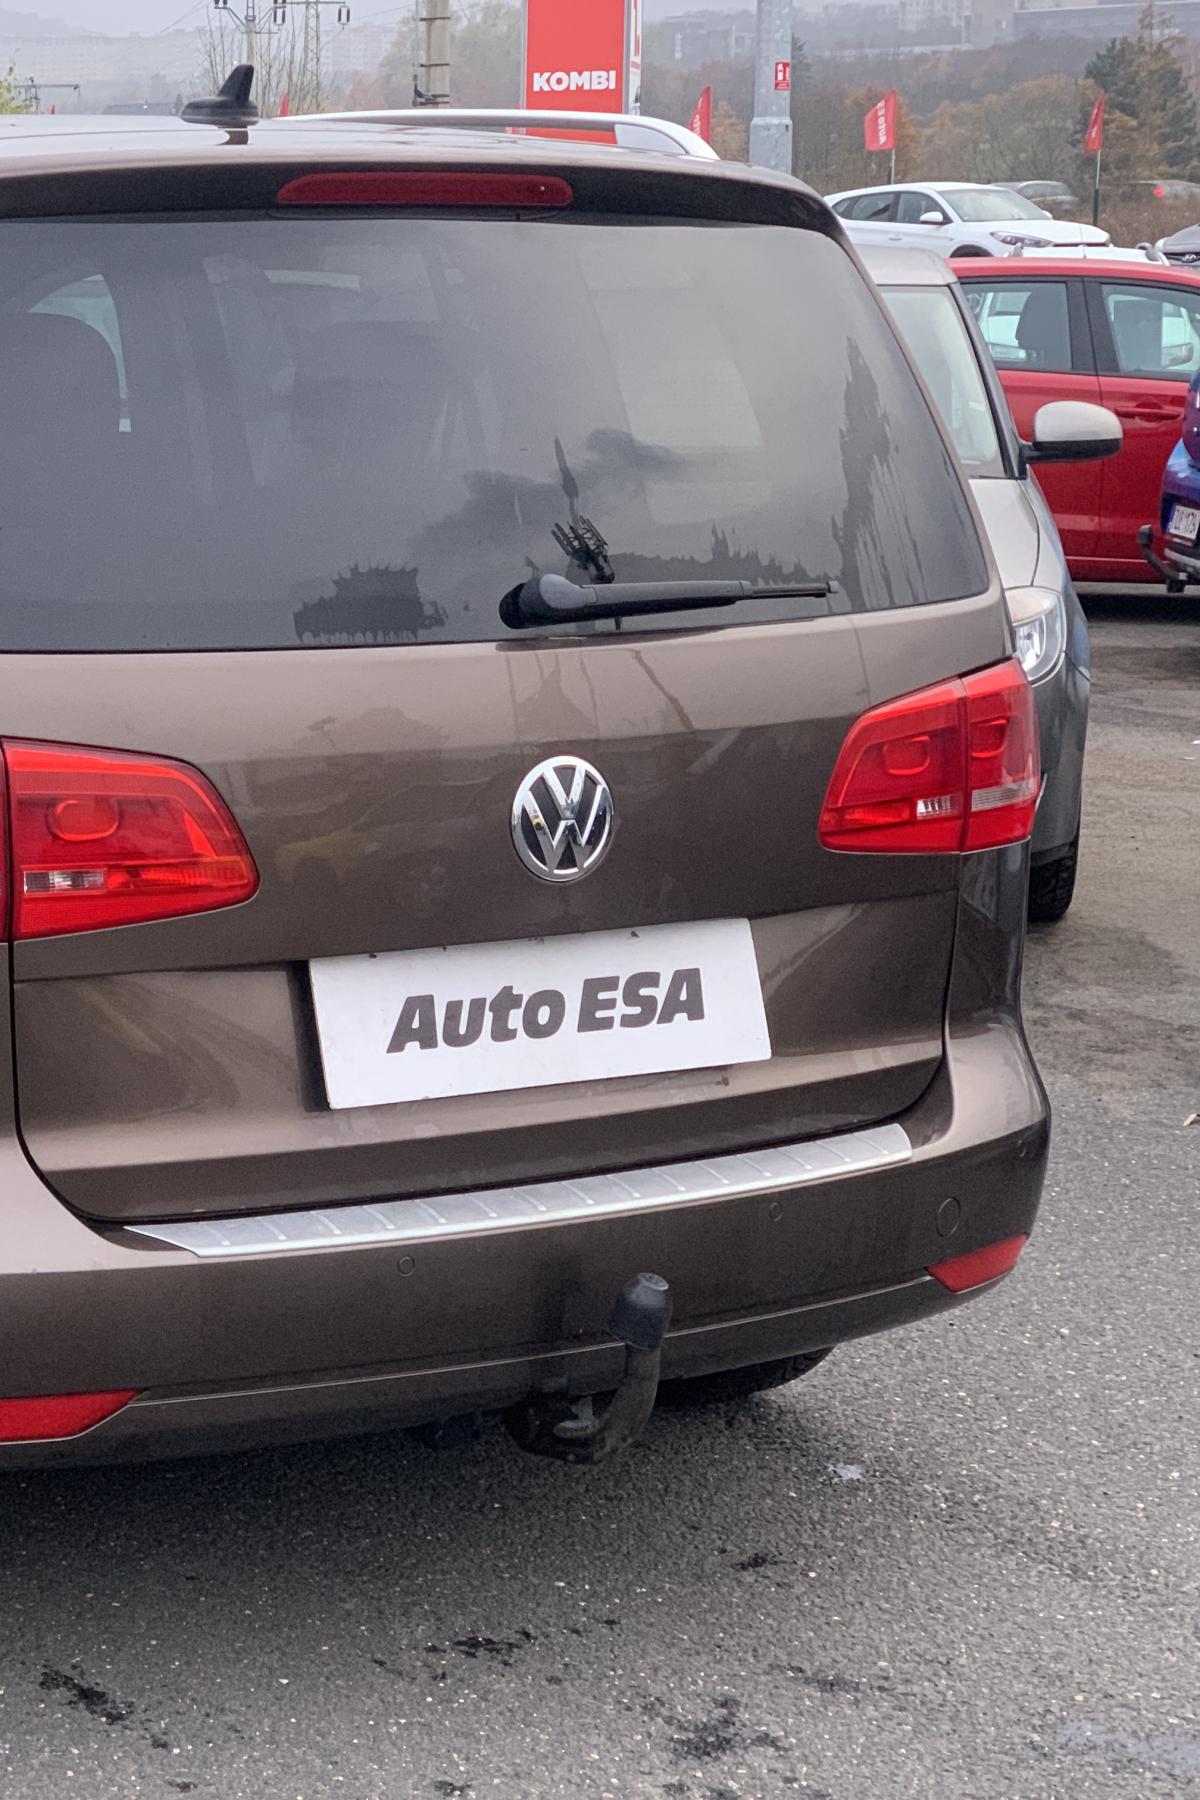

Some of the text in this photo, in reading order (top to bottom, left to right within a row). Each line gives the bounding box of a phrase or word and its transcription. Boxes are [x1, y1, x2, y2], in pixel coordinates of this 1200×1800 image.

[533, 70, 616, 91] KOMBI
[386, 968, 705, 1054] Auto ESA
